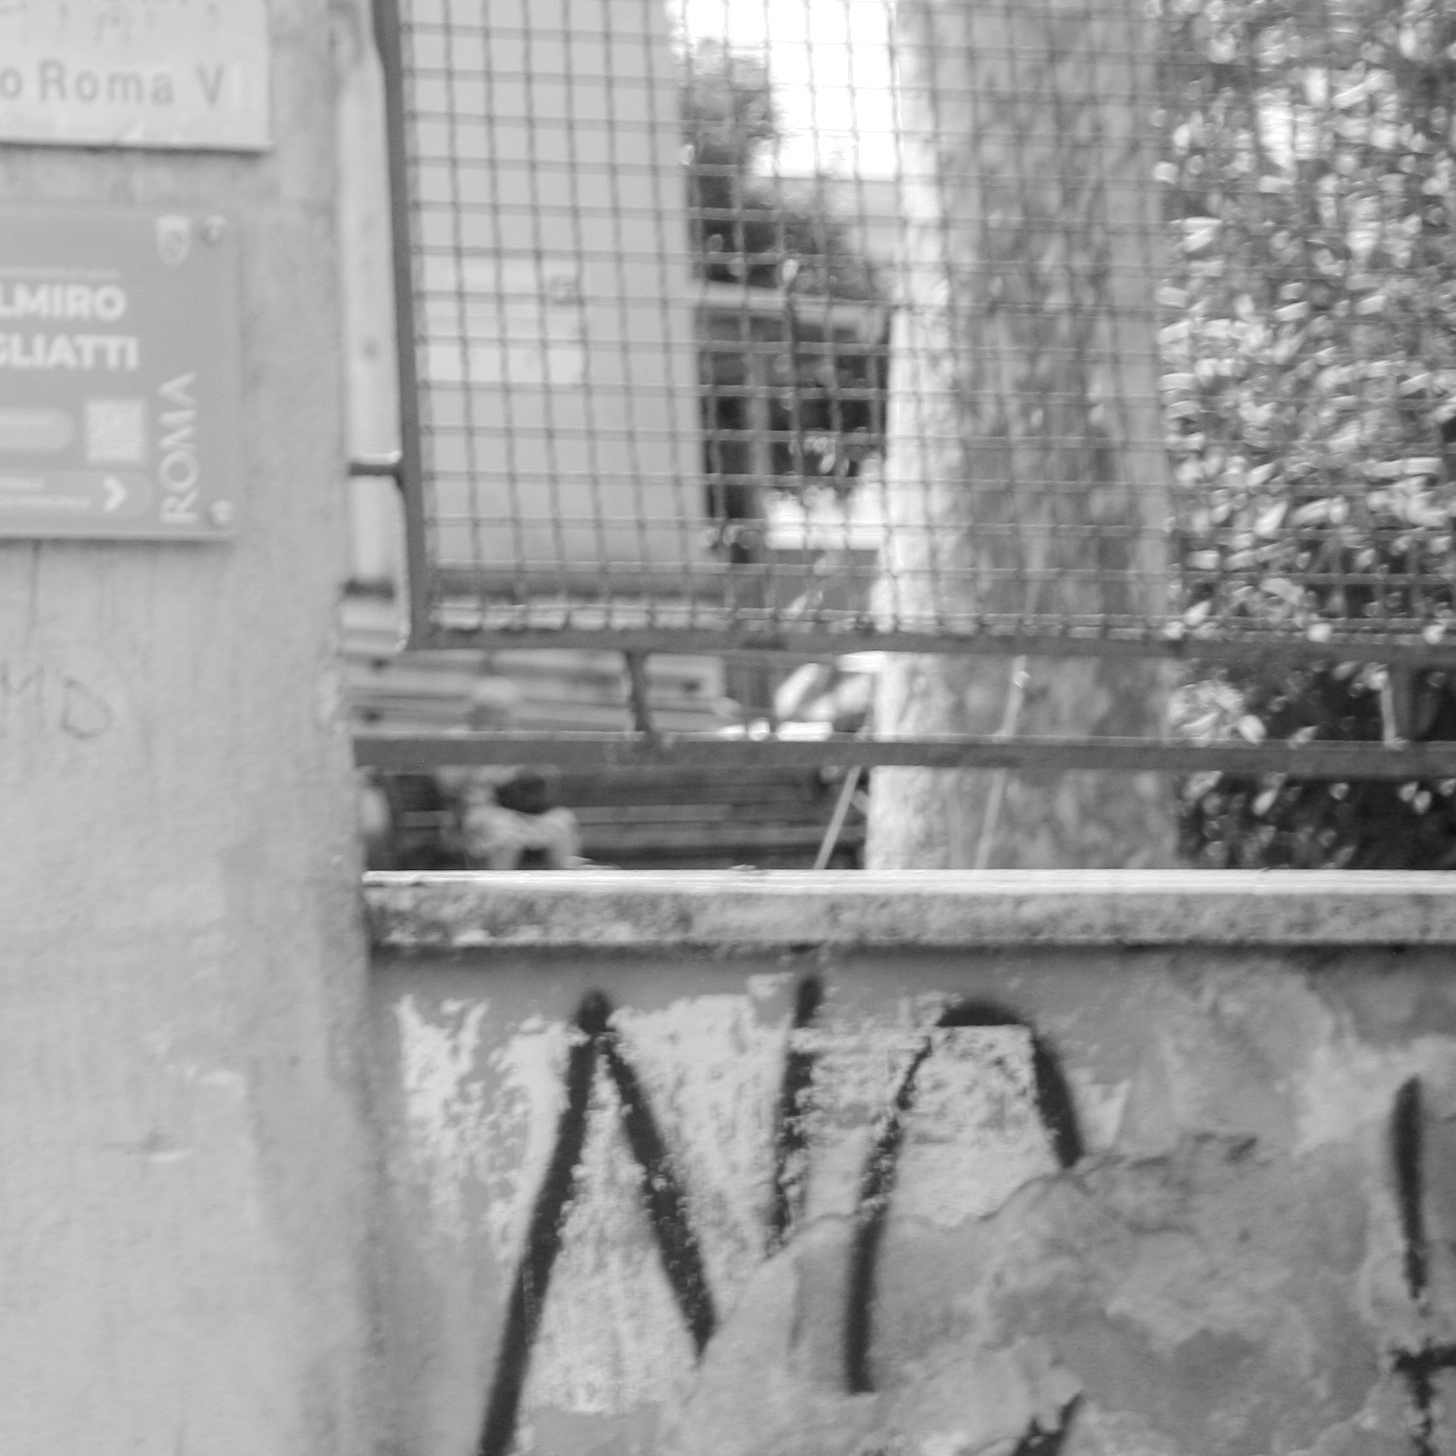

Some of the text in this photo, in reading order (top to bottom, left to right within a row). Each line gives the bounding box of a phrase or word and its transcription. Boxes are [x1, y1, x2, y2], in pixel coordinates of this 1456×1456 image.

[38, 57, 175, 106] Roma
[195, 62, 225, 106] V
[158, 372, 200, 524] ROMA
